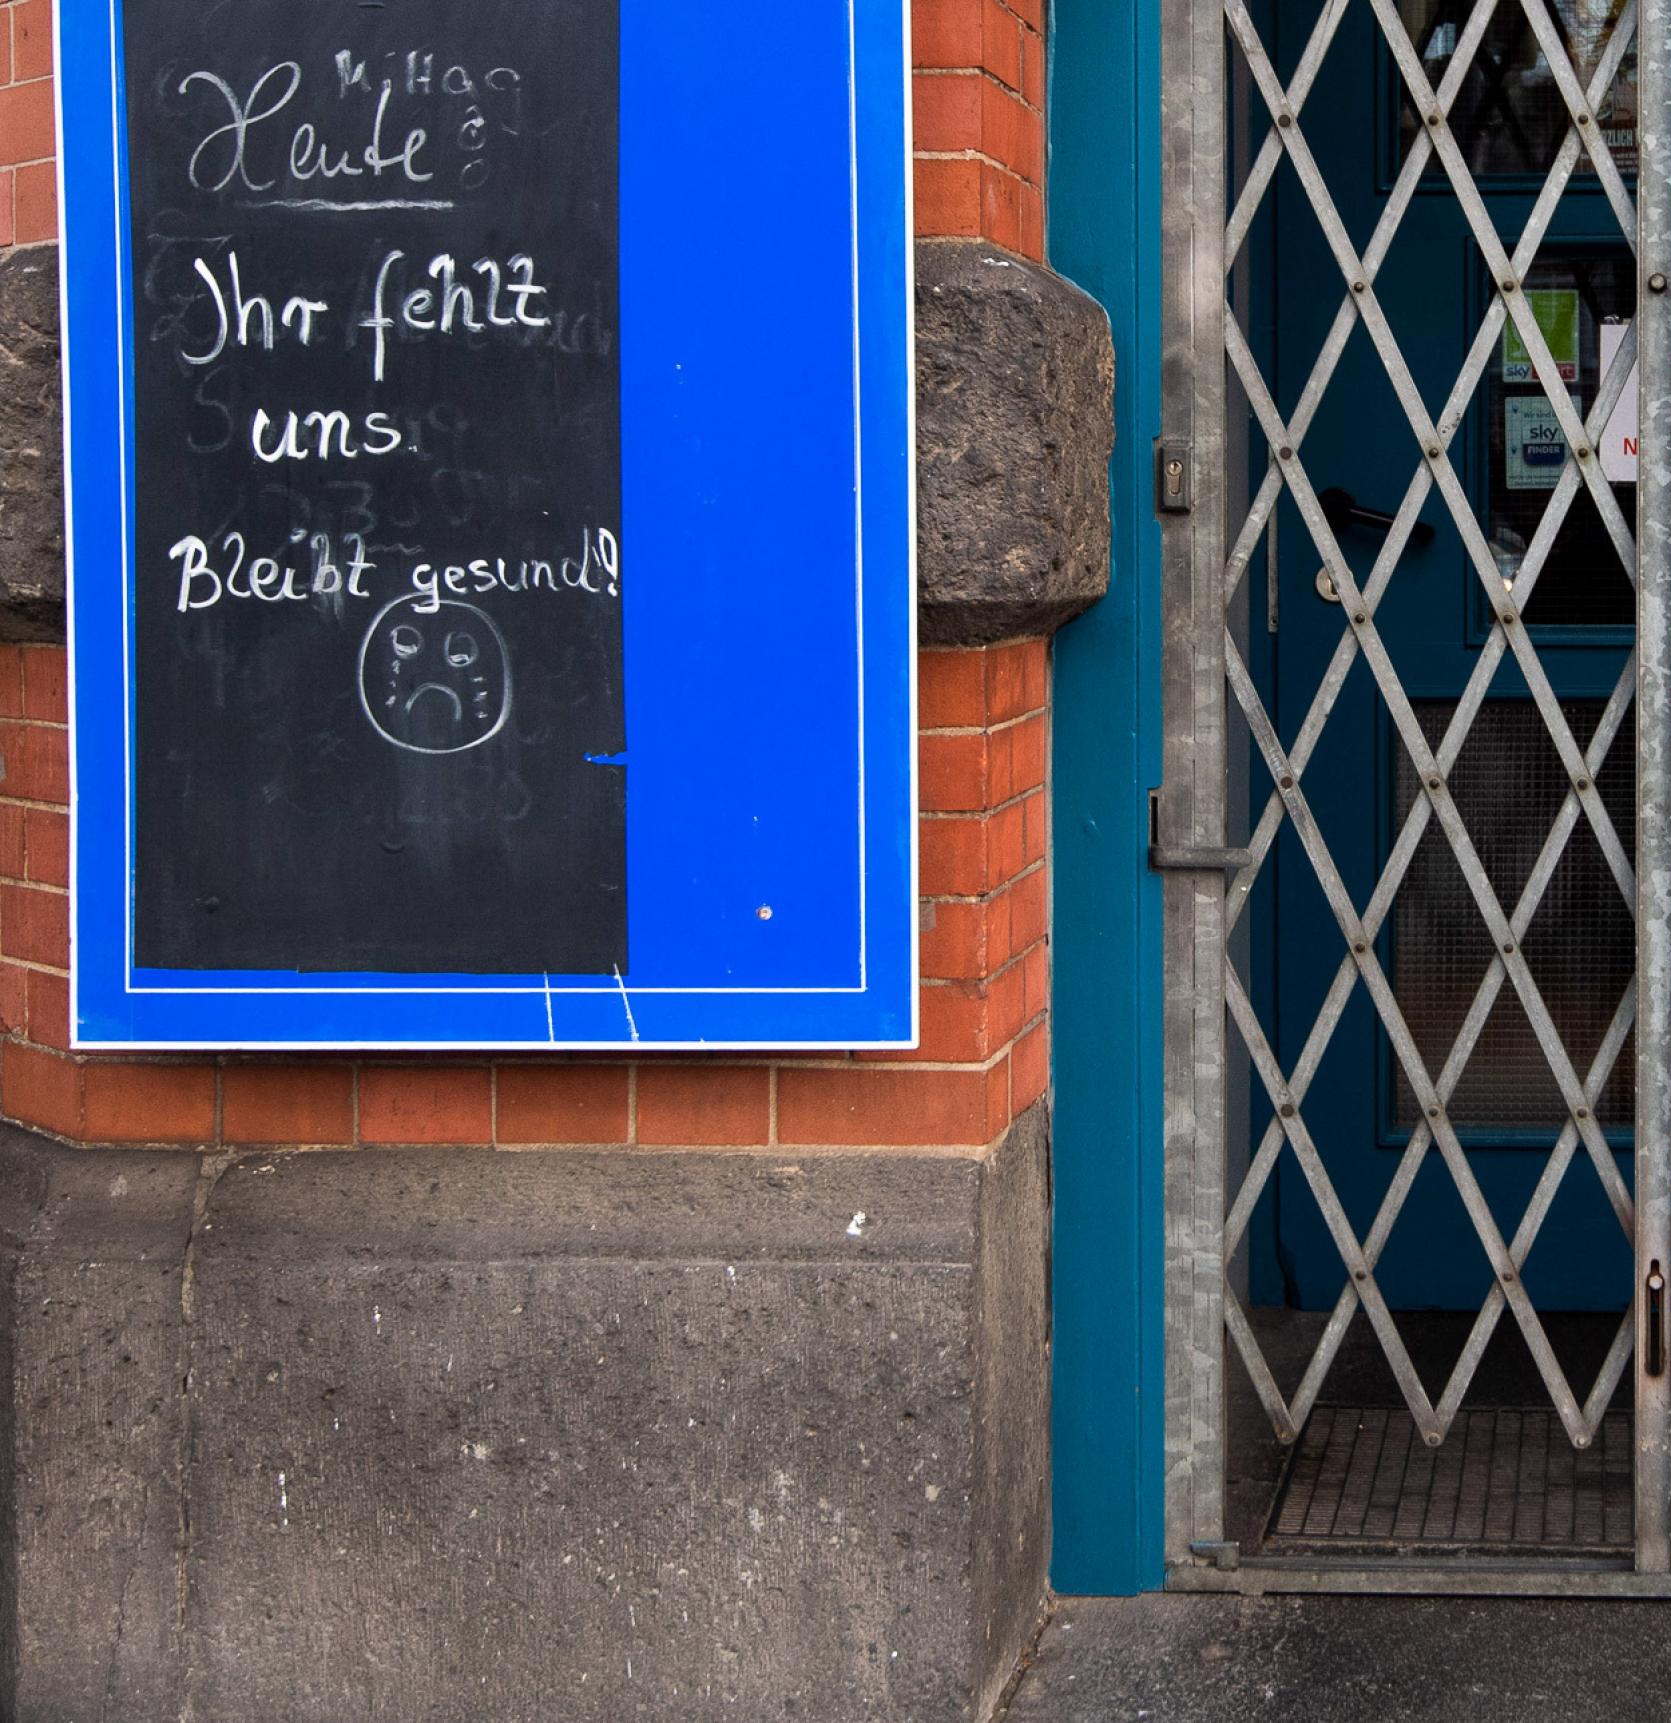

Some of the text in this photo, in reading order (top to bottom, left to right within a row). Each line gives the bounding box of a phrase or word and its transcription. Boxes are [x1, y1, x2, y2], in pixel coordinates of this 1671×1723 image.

[358, 250, 551, 382] fehlt
[1506, 364, 1530, 380] sky
[1529, 424, 1559, 442] sky
[1527, 445, 1561, 455] FINDER
[168, 526, 619, 614] Bleibt gesund!
